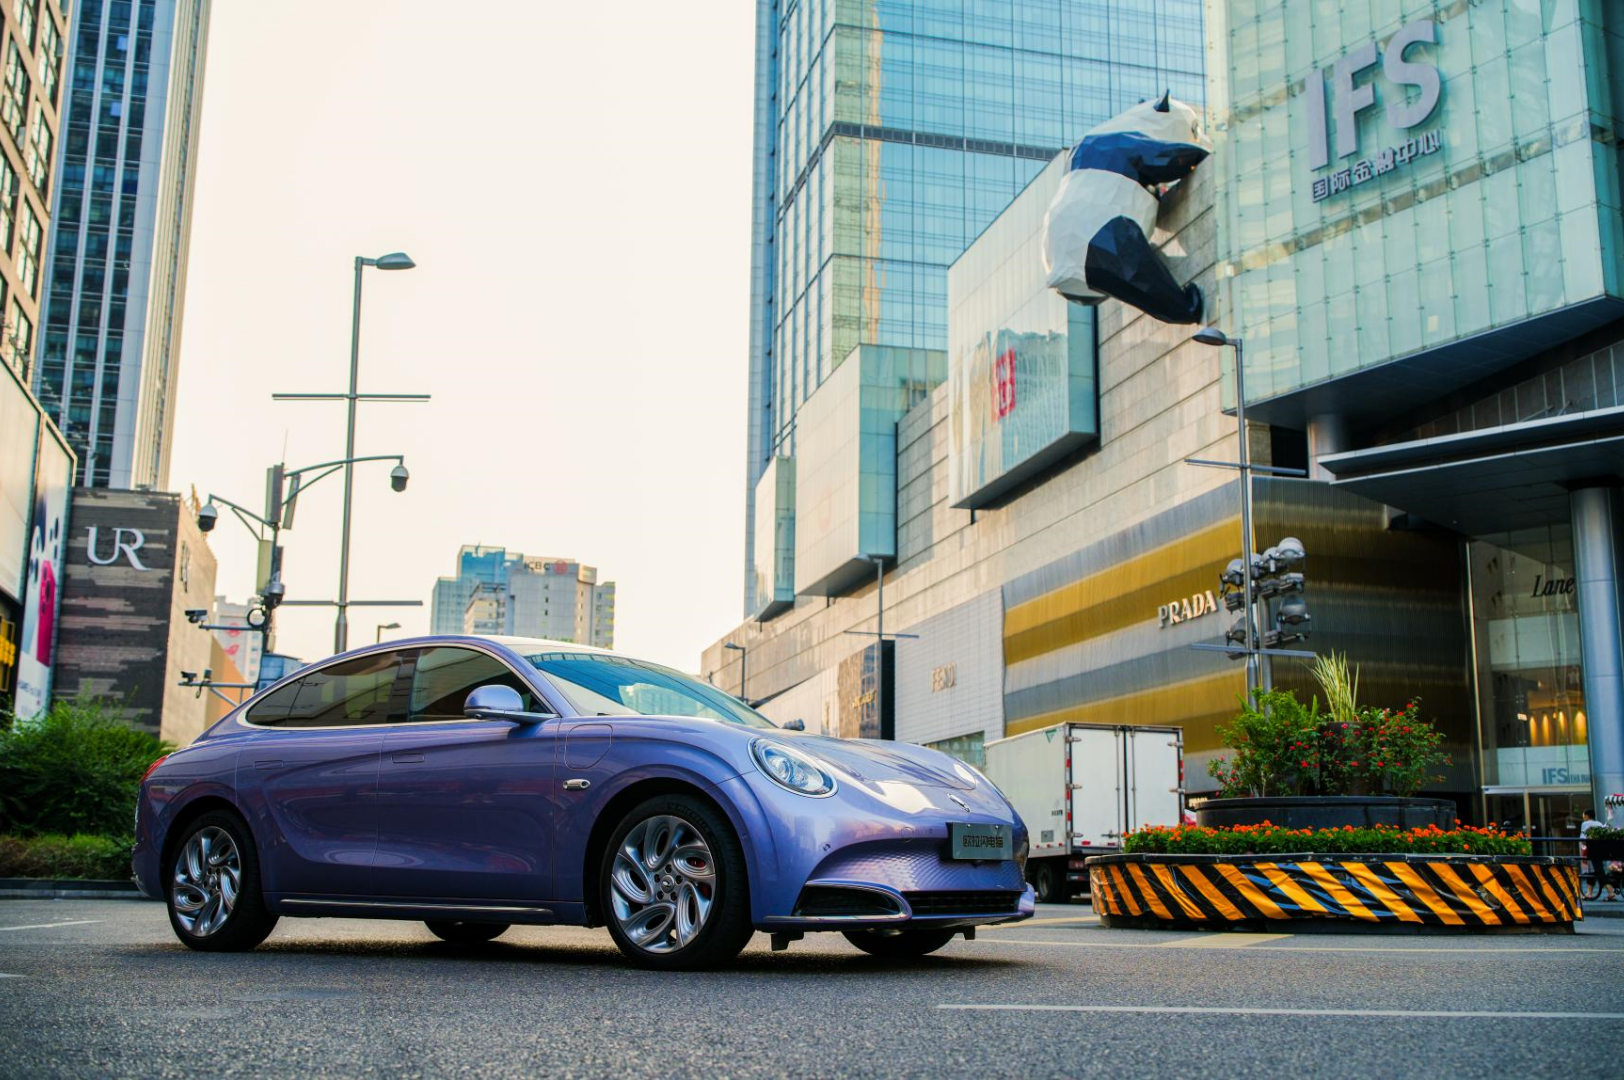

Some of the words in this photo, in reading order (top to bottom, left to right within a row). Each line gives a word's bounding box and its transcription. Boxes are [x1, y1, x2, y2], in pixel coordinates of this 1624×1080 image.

[1305, 19, 1440, 171] IFS
[1312, 129, 1441, 203] 国际金融中心
[85, 526, 152, 571] UR
[1530, 574, 1575, 598] Lane
[1158, 589, 1218, 628] PRADA
[1541, 768, 1569, 785] IFS
